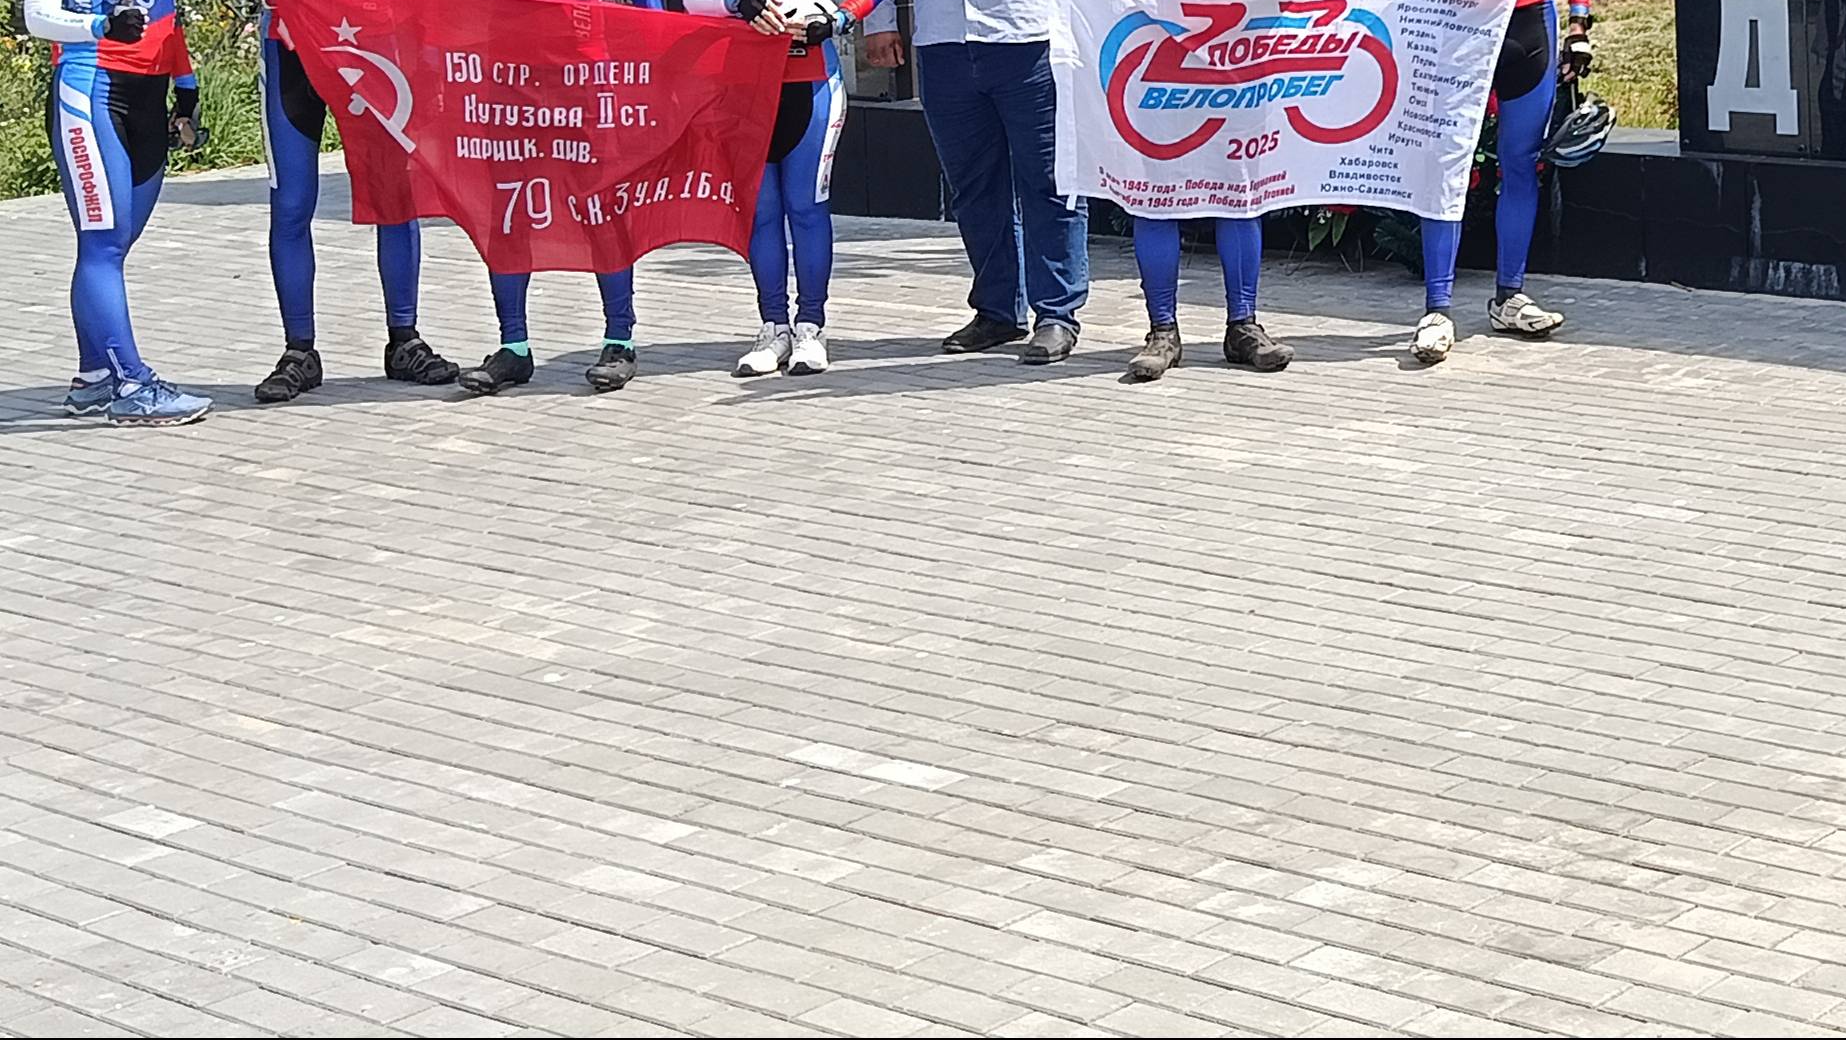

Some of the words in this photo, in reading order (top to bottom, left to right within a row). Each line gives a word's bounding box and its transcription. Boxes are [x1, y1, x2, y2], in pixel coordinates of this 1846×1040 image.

[1208, 32, 1360, 67] ПОБЕДЫ
[1407, 41, 1438, 54] Казань
[445, 52, 483, 83] 150
[563, 61, 650, 86] ОРДЕНА
[1138, 75, 1344, 110] ВЕЛОПРОБЕГ
[1227, 130, 1281, 160] 2025
[1369, 145, 1394, 155] Чита
[1339, 157, 1399, 169] Хабаровск
[68, 127, 103, 222] РОСПРОФЖЕЛ
[1329, 170, 1401, 183] Владивосток
[1122, 179, 1149, 192] 1945
[1151, 184, 1176, 194] года
[1185, 179, 1224, 193] Победа
[1227, 183, 1247, 194] над
[1320, 183, 1413, 199] Южно-Сахалинск
[496, 177, 552, 234] 79
[1147, 196, 1174, 208] 1945
[1176, 197, 1199, 207] года
[1208, 194, 1248, 208] Победа
